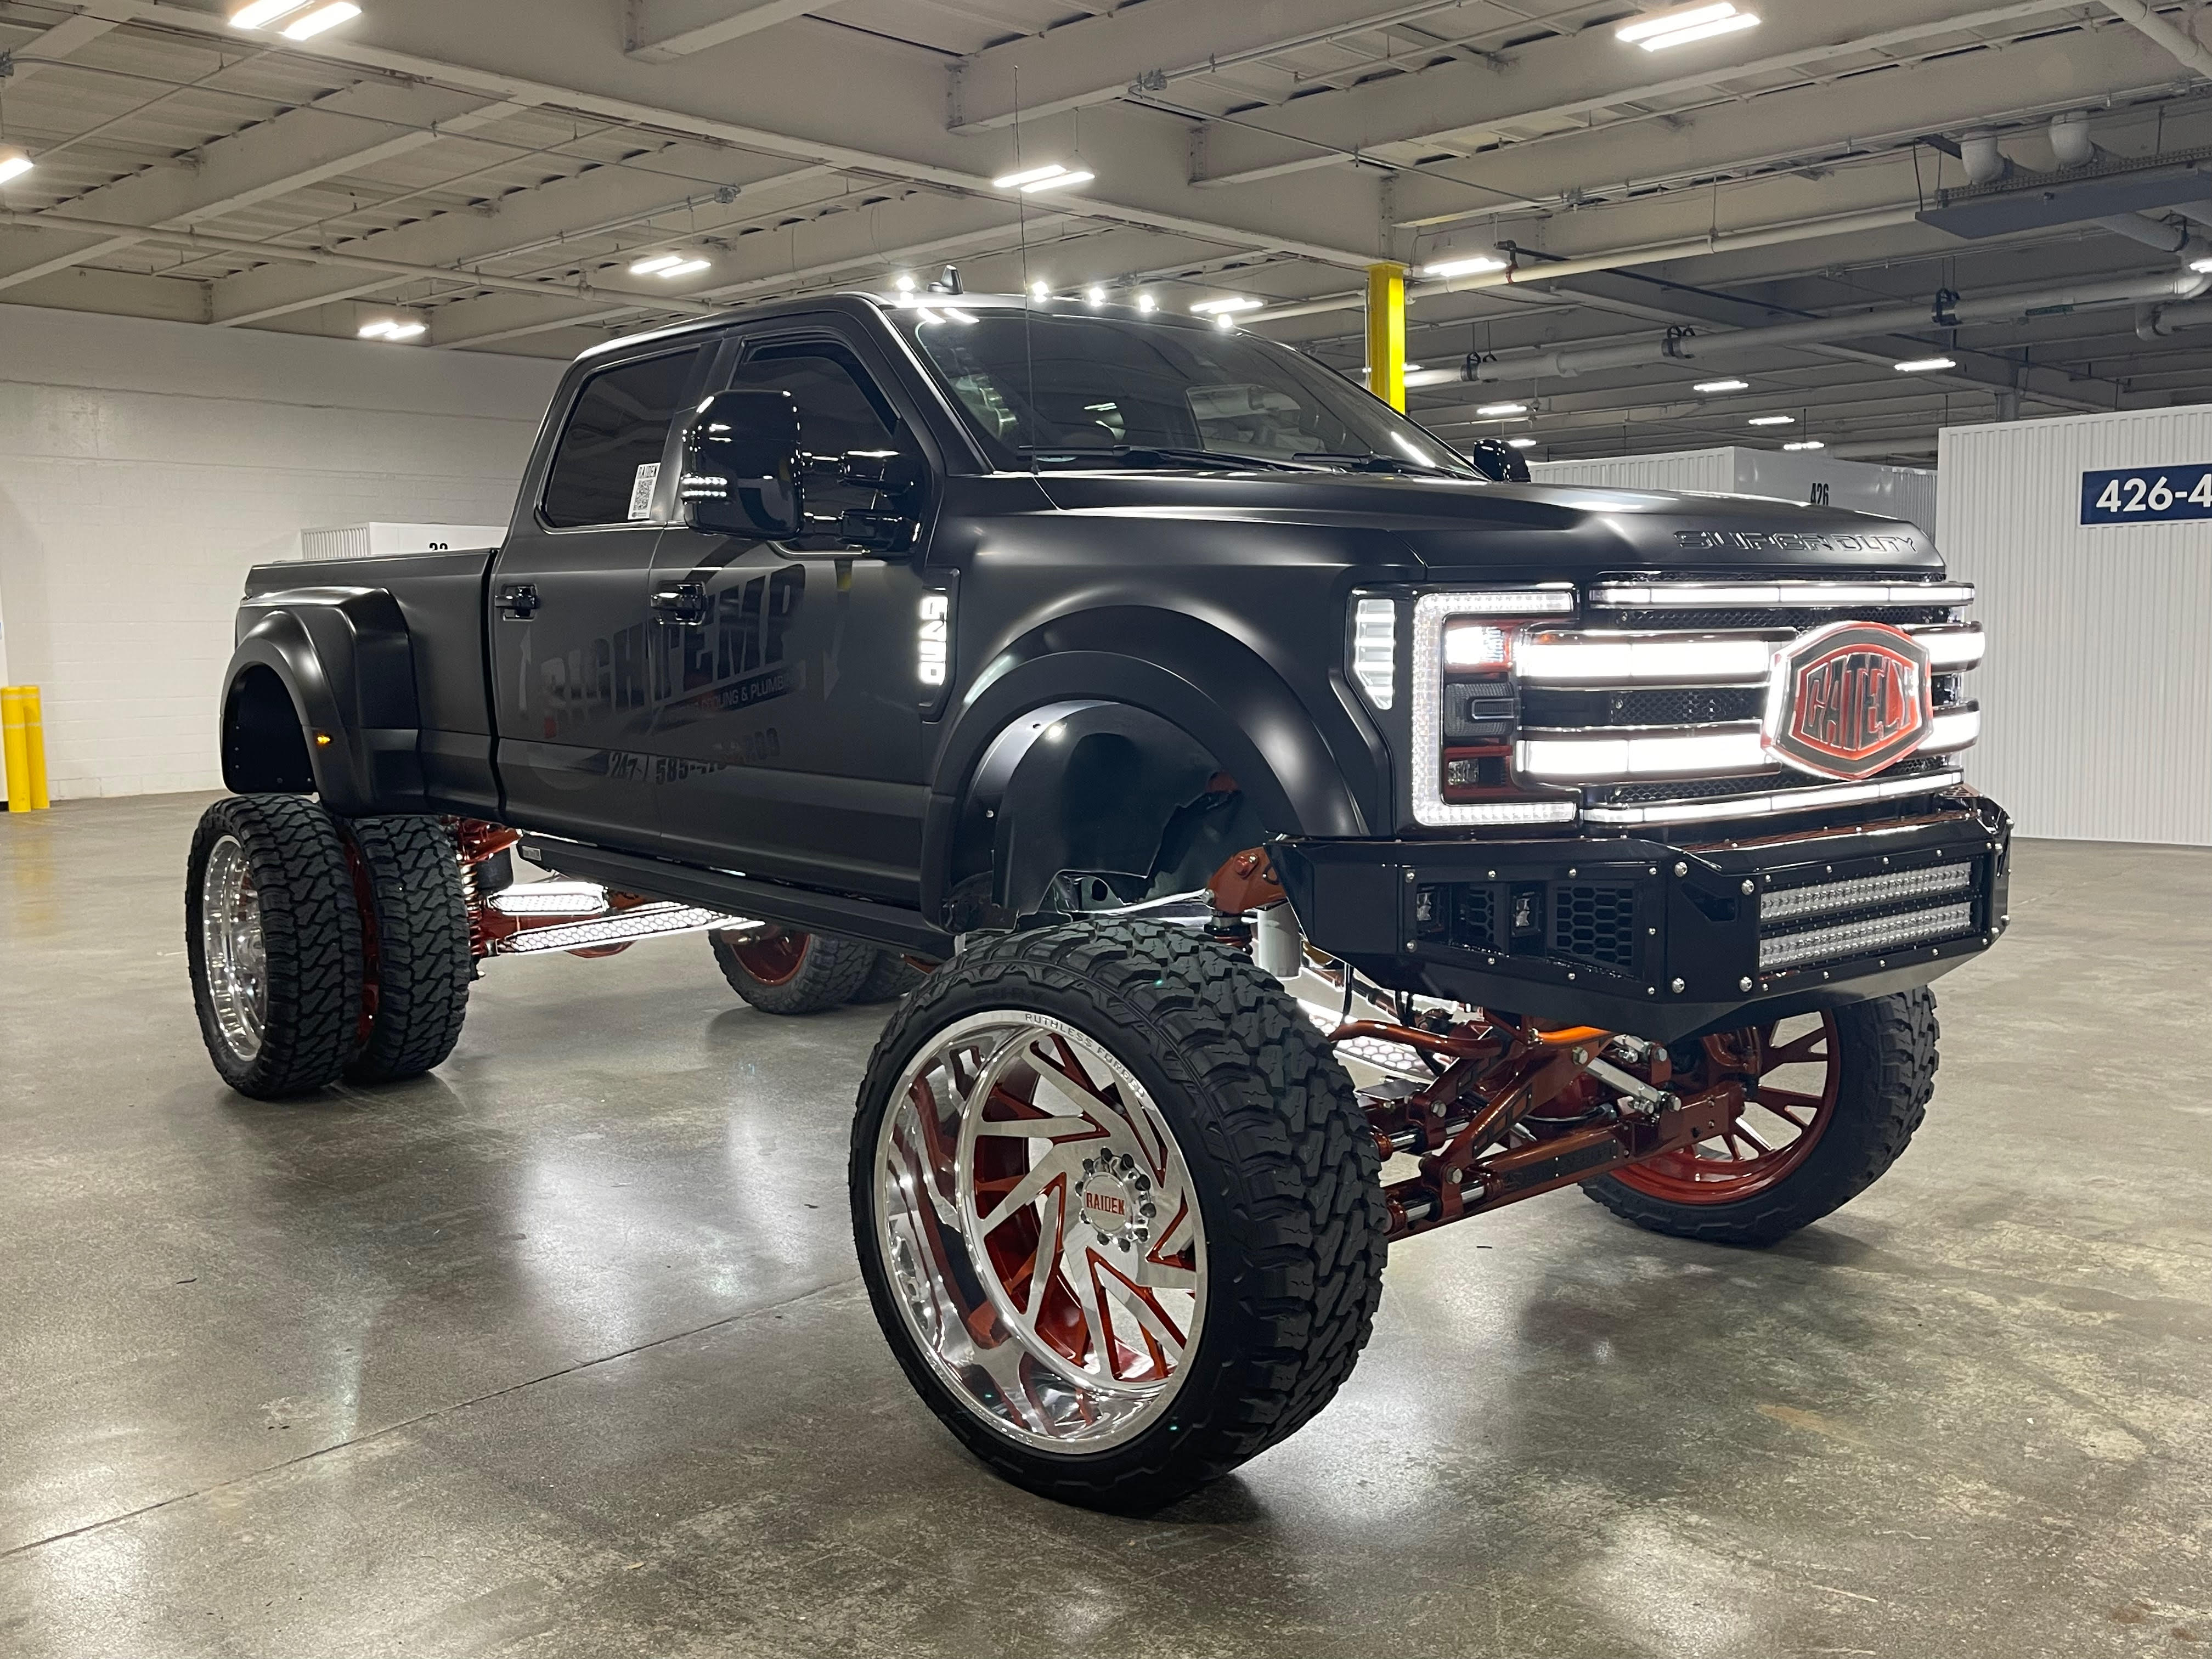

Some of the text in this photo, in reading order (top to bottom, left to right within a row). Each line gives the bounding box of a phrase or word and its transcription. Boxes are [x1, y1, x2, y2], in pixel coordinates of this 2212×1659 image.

[1810, 483, 1829, 506] 426
[2096, 473, 2212, 512] 426-4
[1674, 530, 1918, 552] SUPER DUTY
[741, 686, 749, 702] &
[1025, 1013, 1146, 1098] RUTHLESS FORGED
[1086, 1192, 1125, 1216] RAIDEN
